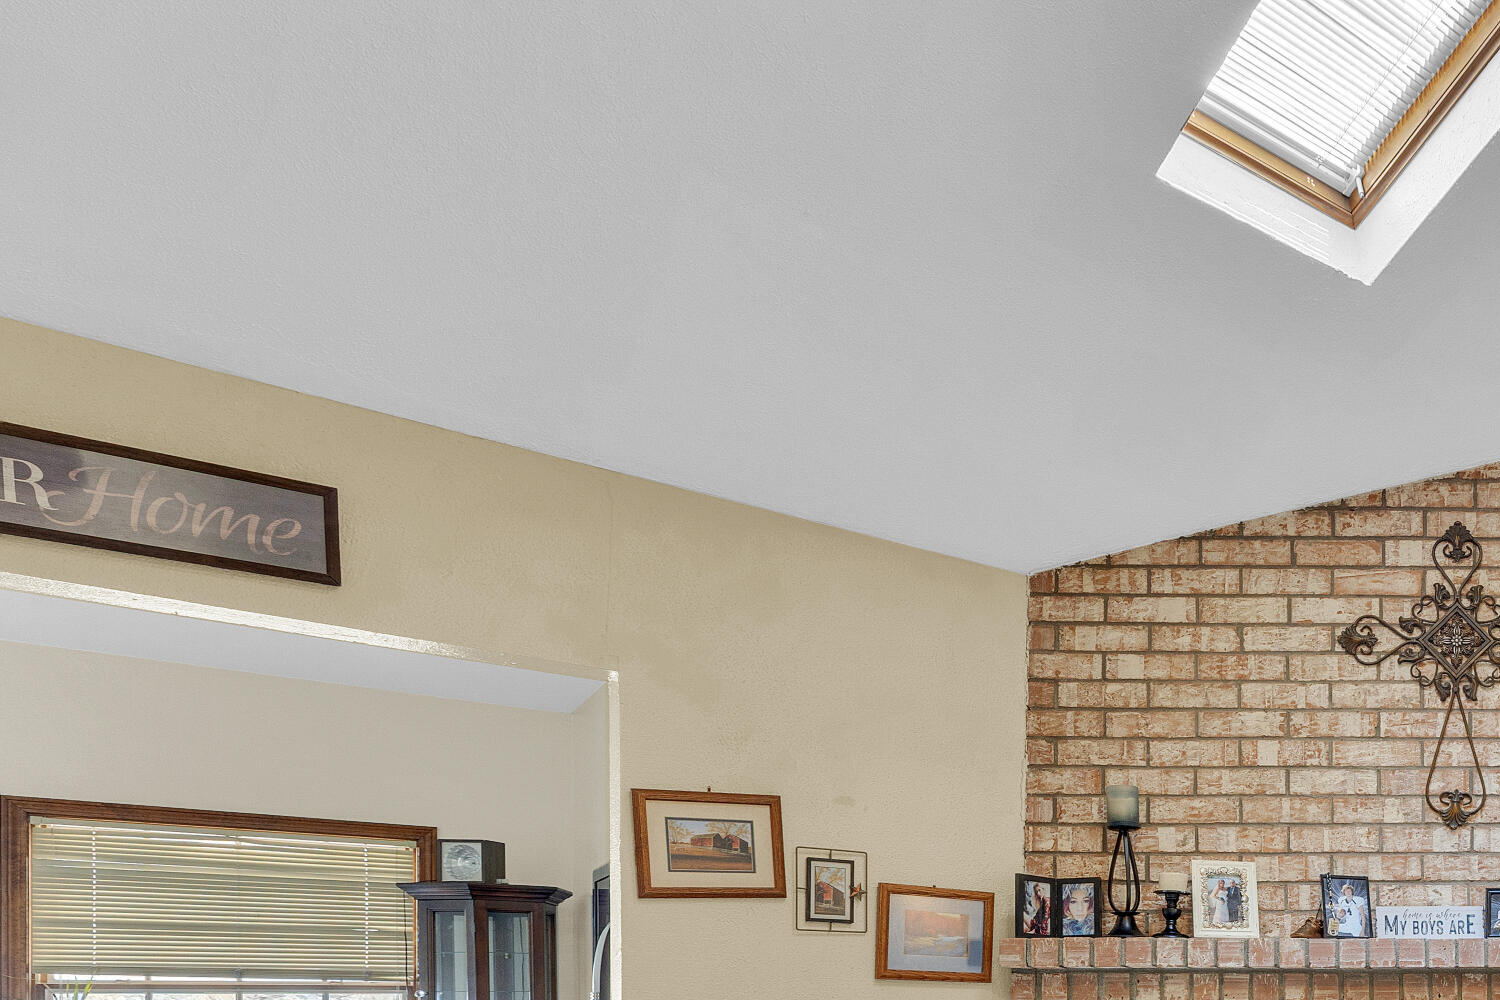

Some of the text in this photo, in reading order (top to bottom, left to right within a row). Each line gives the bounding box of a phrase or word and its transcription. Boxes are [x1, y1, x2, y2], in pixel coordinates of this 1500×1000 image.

[40, 466, 302, 556] Home
[1384, 914, 1476, 935] MY BOYS ARE
